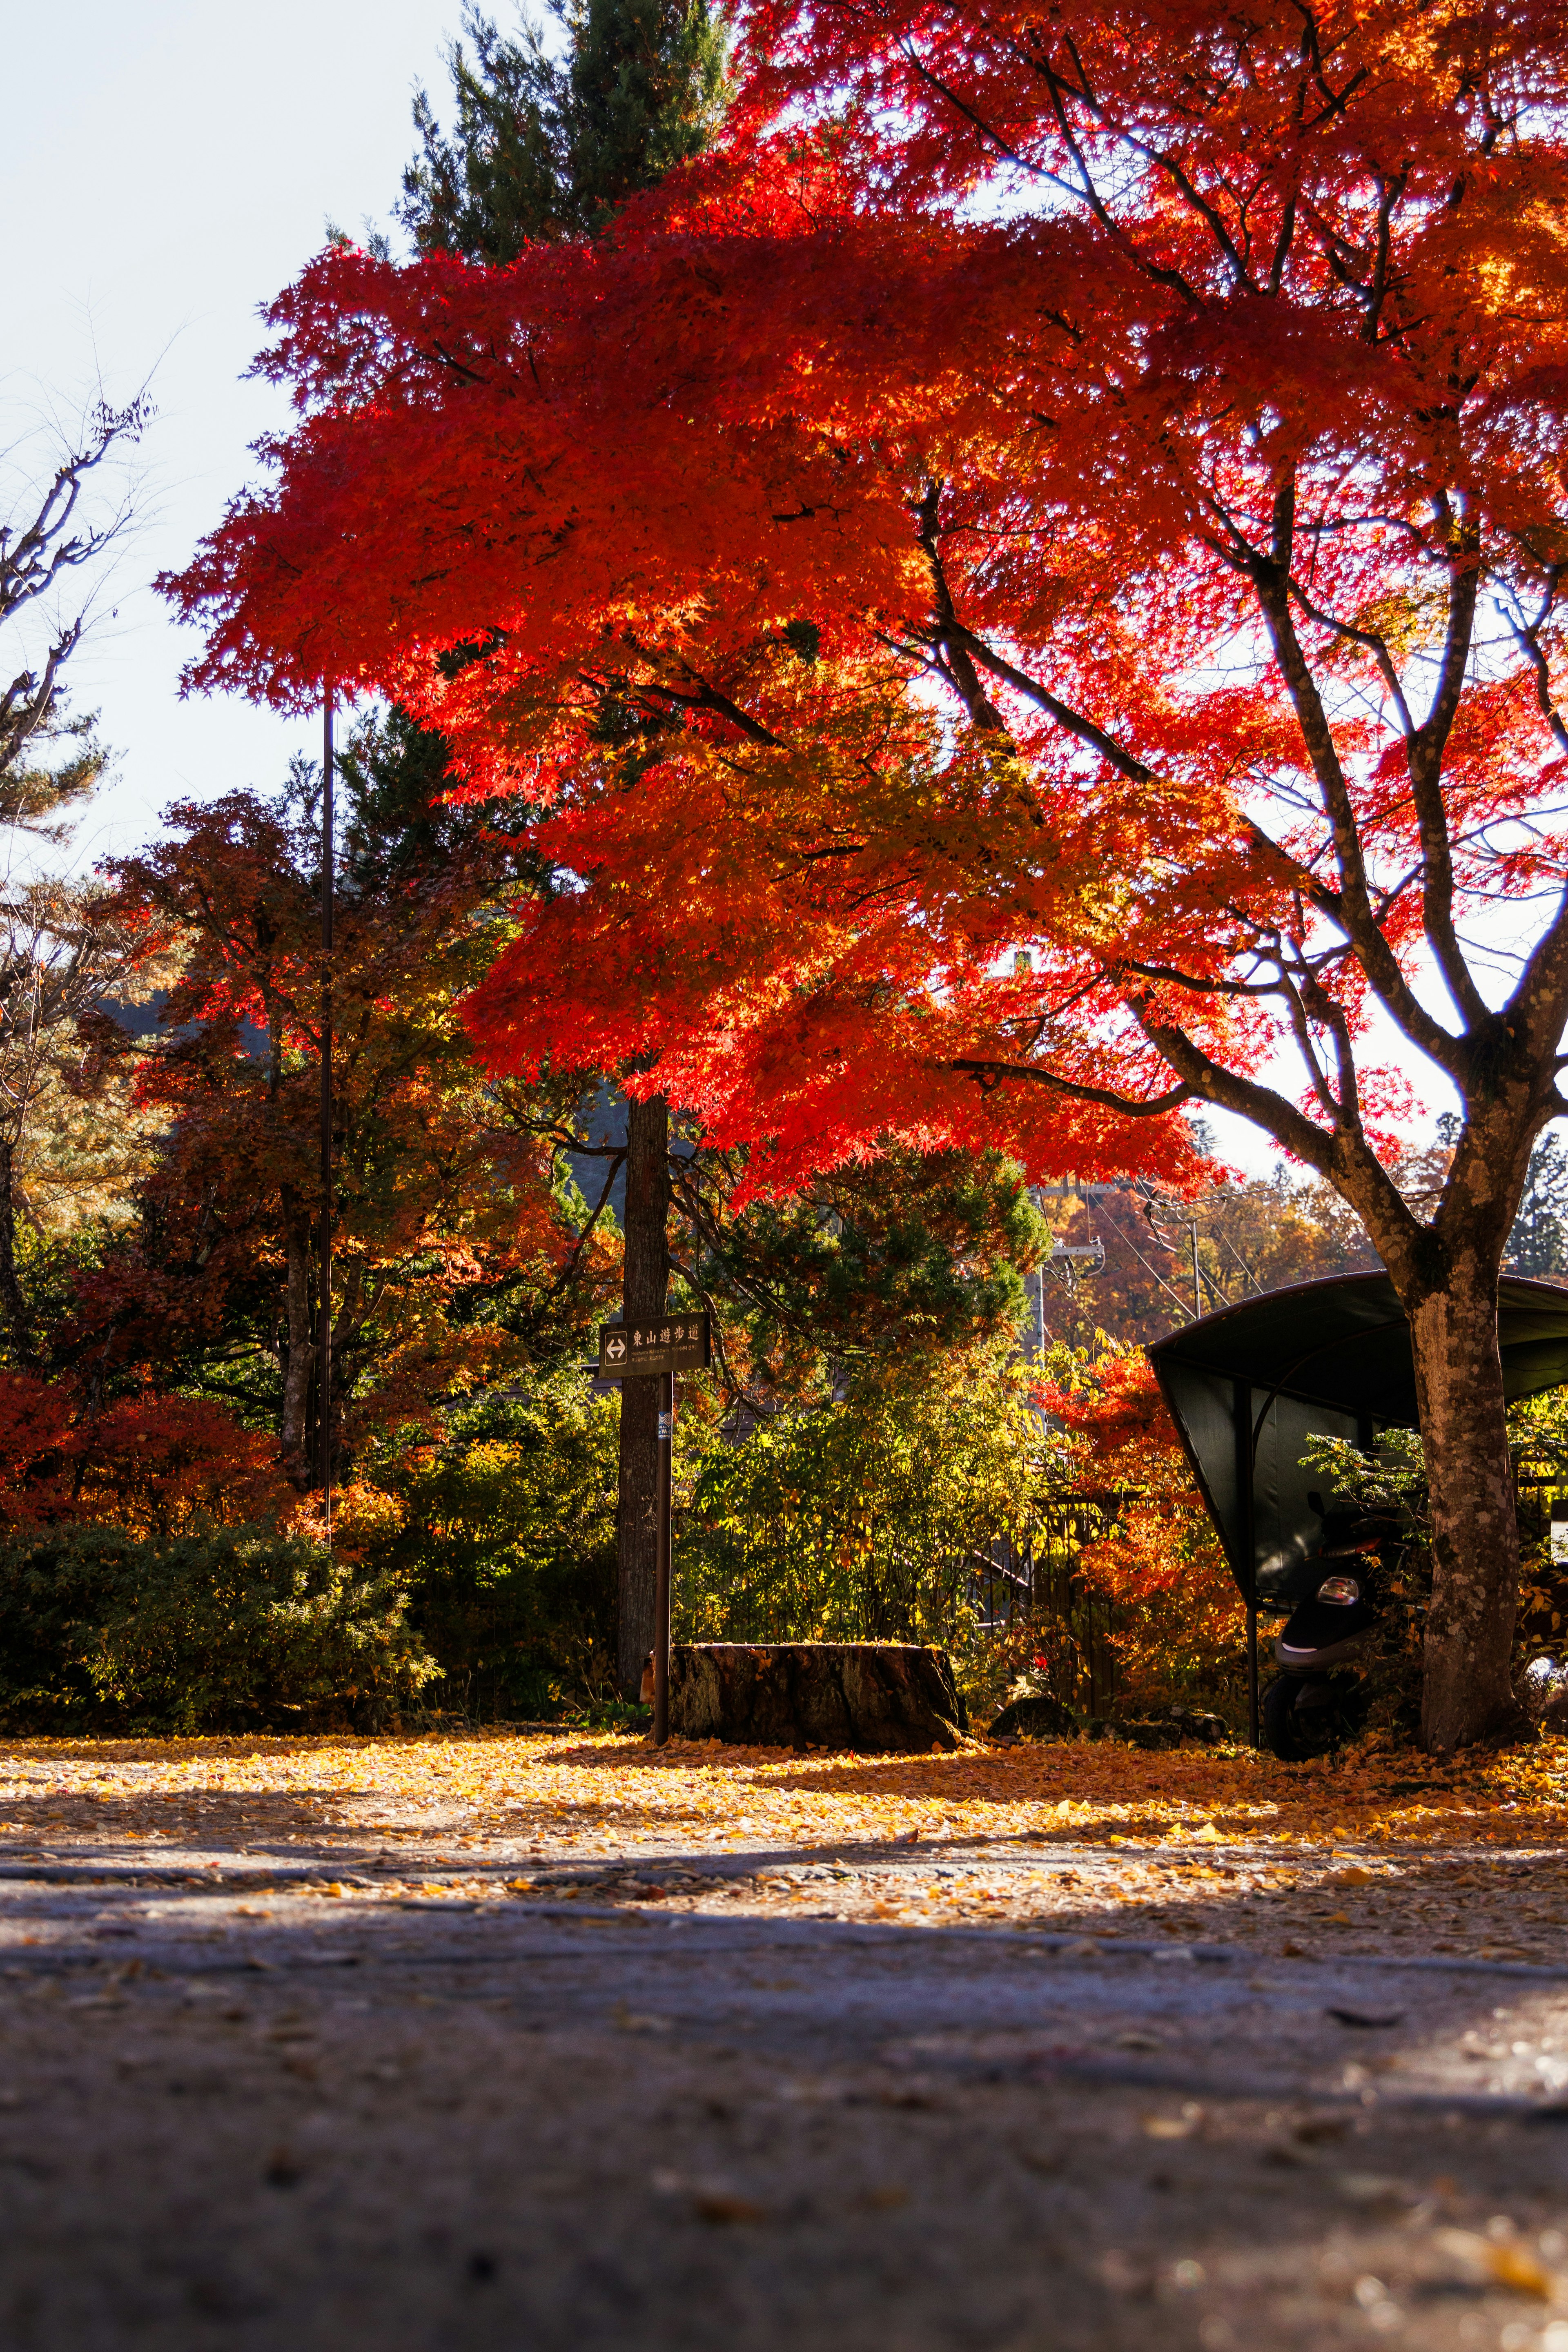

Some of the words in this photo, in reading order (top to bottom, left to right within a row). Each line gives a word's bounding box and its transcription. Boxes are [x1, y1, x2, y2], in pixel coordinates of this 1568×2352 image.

[633, 1323, 699, 1347] 東山遊歩道
